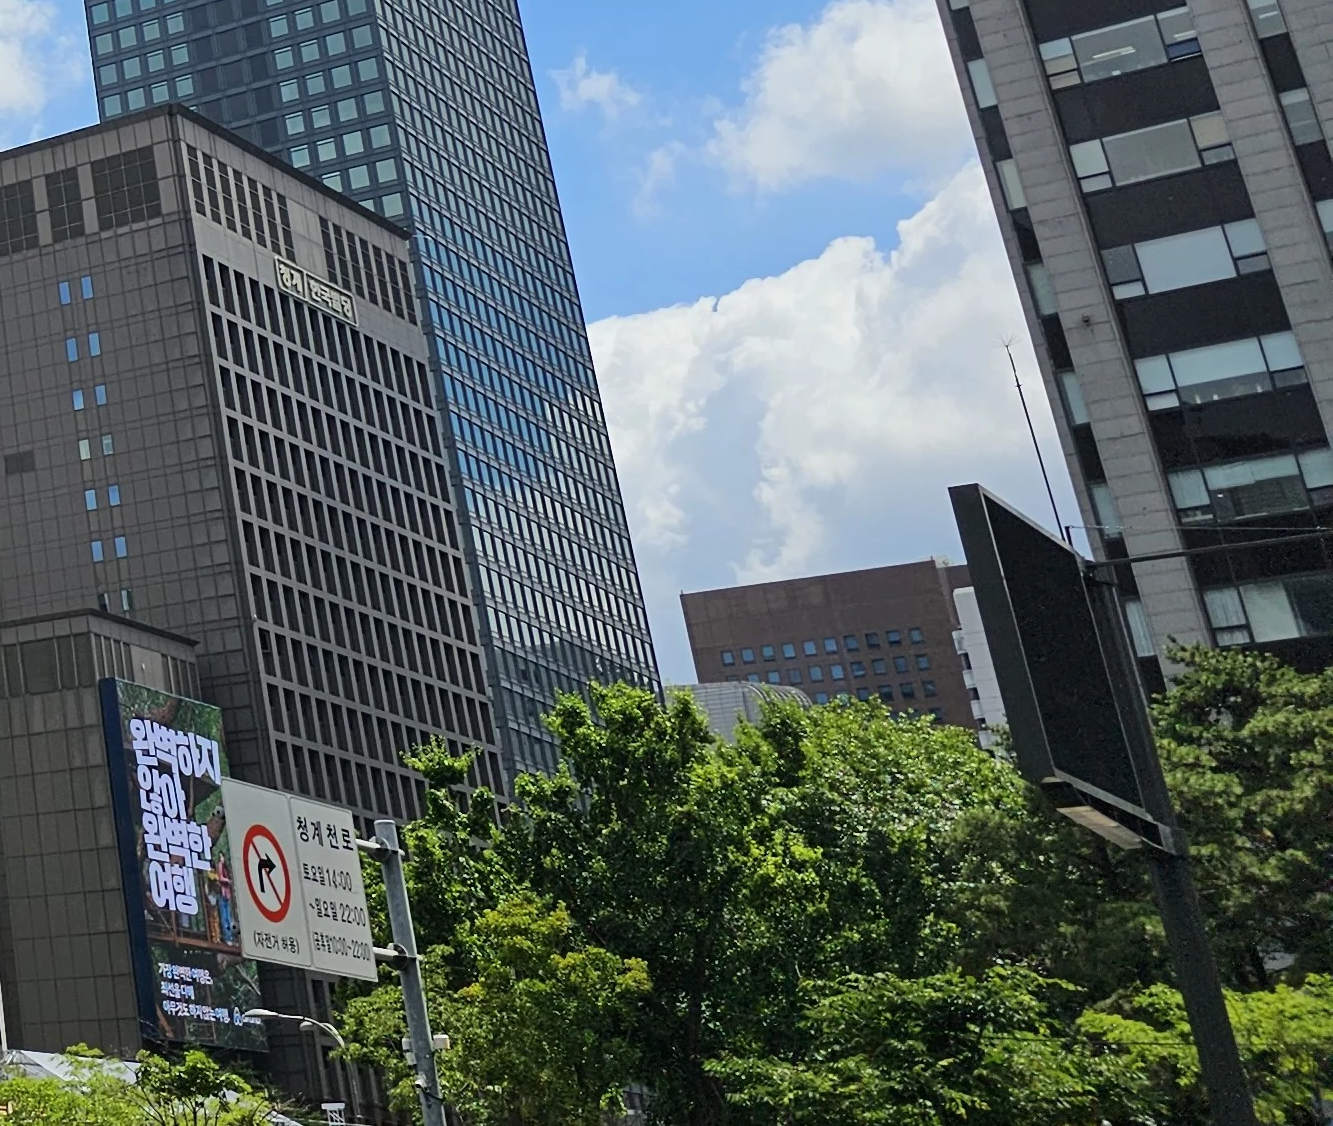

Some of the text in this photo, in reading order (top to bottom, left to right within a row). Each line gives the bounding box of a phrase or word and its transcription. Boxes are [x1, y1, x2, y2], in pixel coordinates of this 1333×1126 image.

[279, 263, 304, 294] 청계
[130, 718, 222, 785] 완벽하지
[137, 764, 188, 820] 않아
[142, 810, 213, 871] 완벽한
[296, 815, 354, 852] 청계천로
[149, 860, 199, 915] 여행
